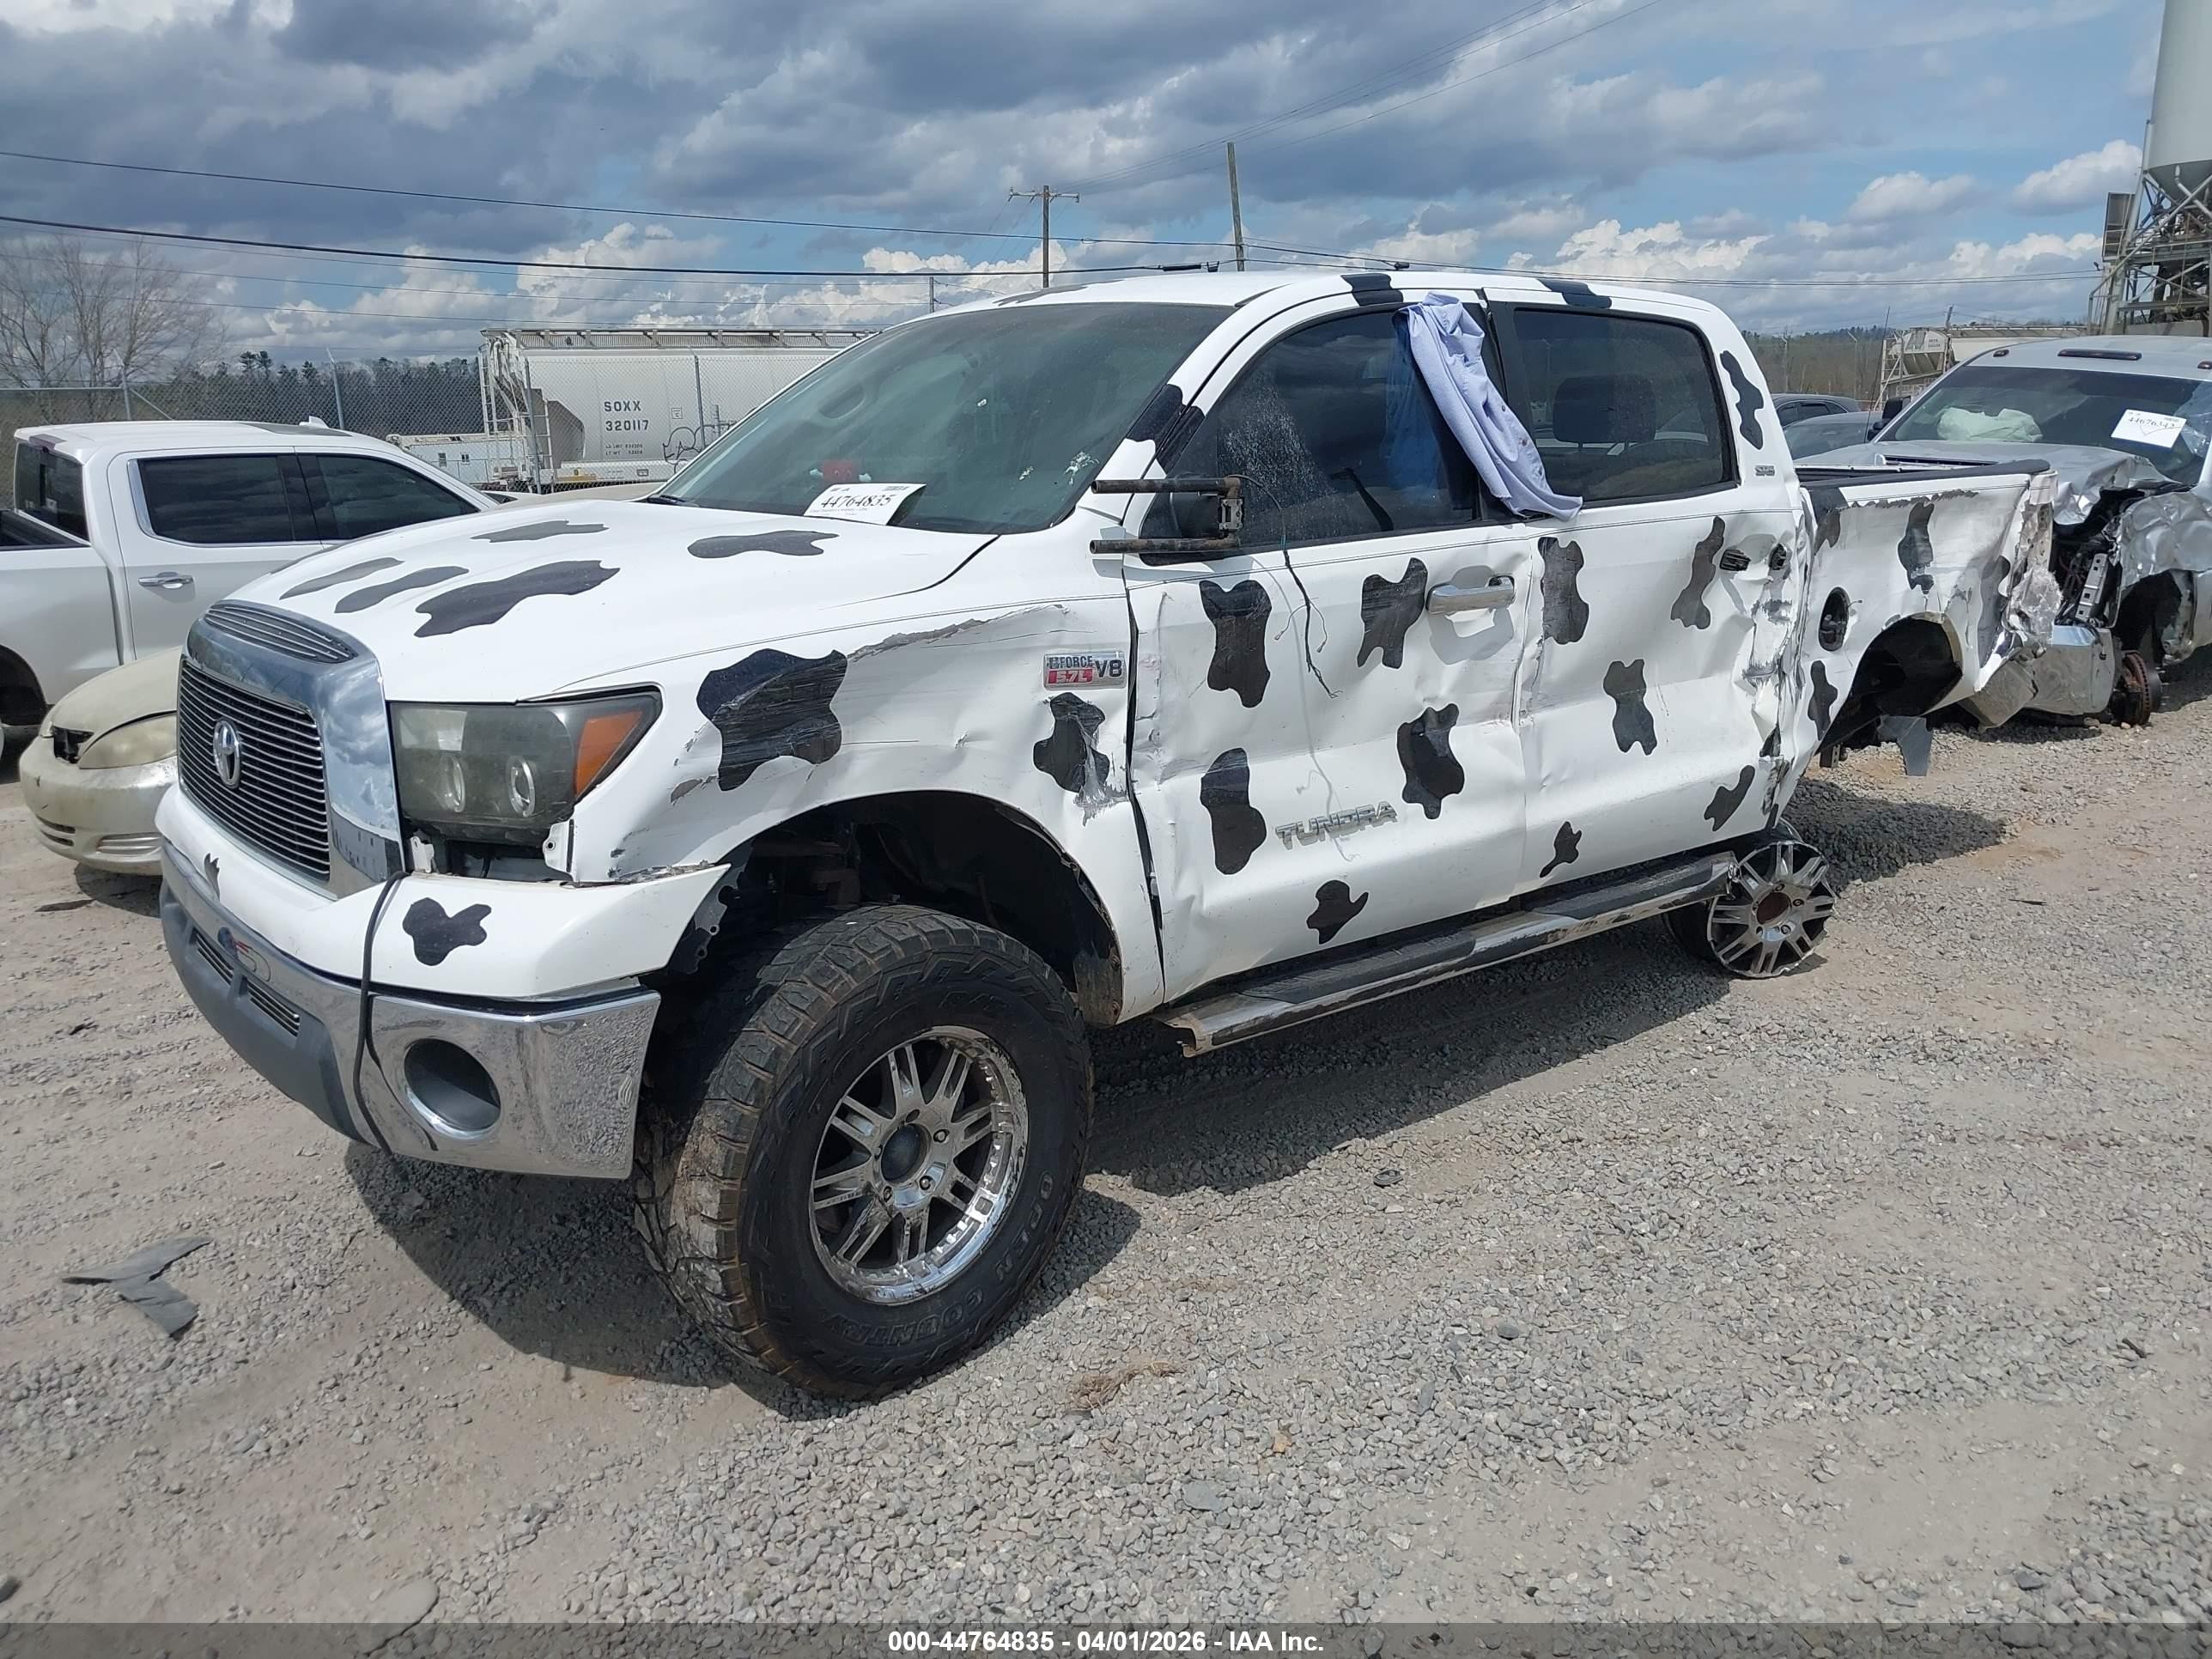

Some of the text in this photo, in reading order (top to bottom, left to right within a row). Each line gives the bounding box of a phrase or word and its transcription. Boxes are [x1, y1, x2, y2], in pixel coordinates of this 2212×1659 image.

[604, 400, 641, 412] SOXX
[605, 419, 649, 432] 320117
[821, 494, 896, 508] 44764835
[1095, 659, 1122, 678] V8
[1055, 670, 1088, 683] 5.7L
[1275, 800, 1398, 850] TUNDRA
